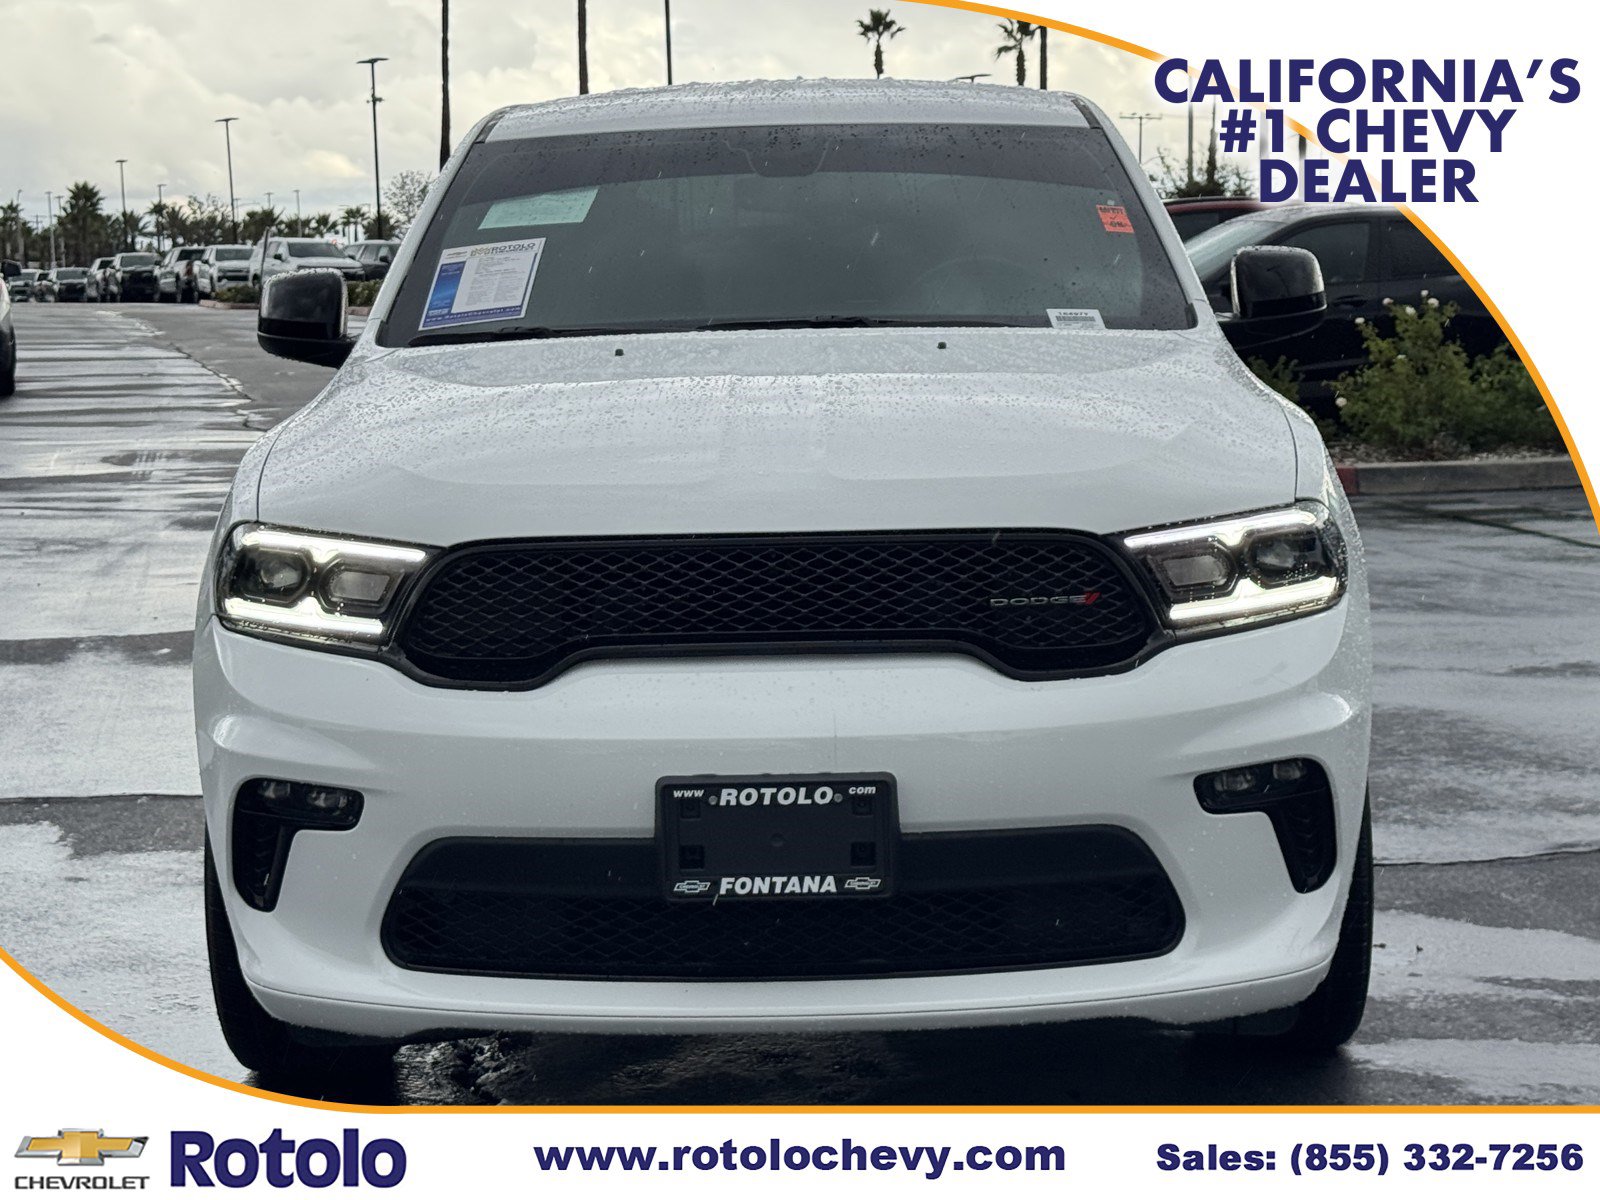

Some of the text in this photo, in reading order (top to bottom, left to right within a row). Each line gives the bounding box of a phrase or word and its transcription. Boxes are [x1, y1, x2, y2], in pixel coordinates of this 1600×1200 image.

[990, 595, 1086, 606] DODGE
[673, 785, 876, 806] www ROTOLO com
[719, 875, 837, 895] FONTANA
